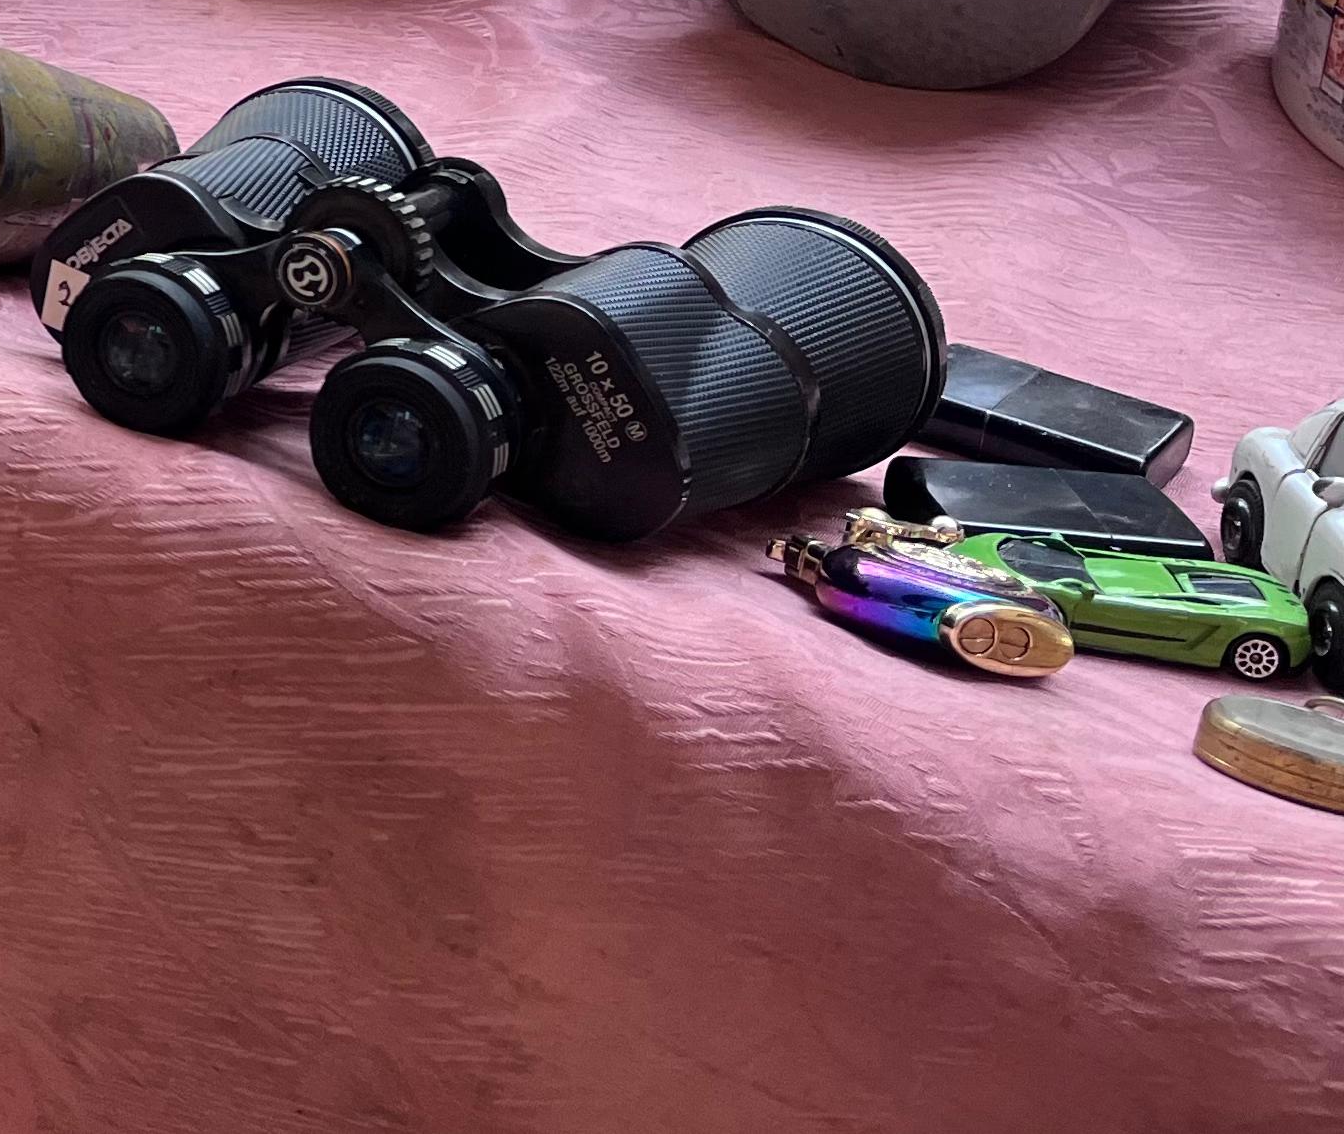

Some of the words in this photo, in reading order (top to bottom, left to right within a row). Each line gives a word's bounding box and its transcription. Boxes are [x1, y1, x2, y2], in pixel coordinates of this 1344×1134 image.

[544, 356, 570, 393] 122m
[565, 395, 588, 417] auf
[582, 419, 612, 463] 1000m
[563, 362, 621, 449] GROSSFELD
[585, 351, 609, 375] 10
[610, 393, 634, 418] 50
[589, 381, 618, 423] COMPACT
